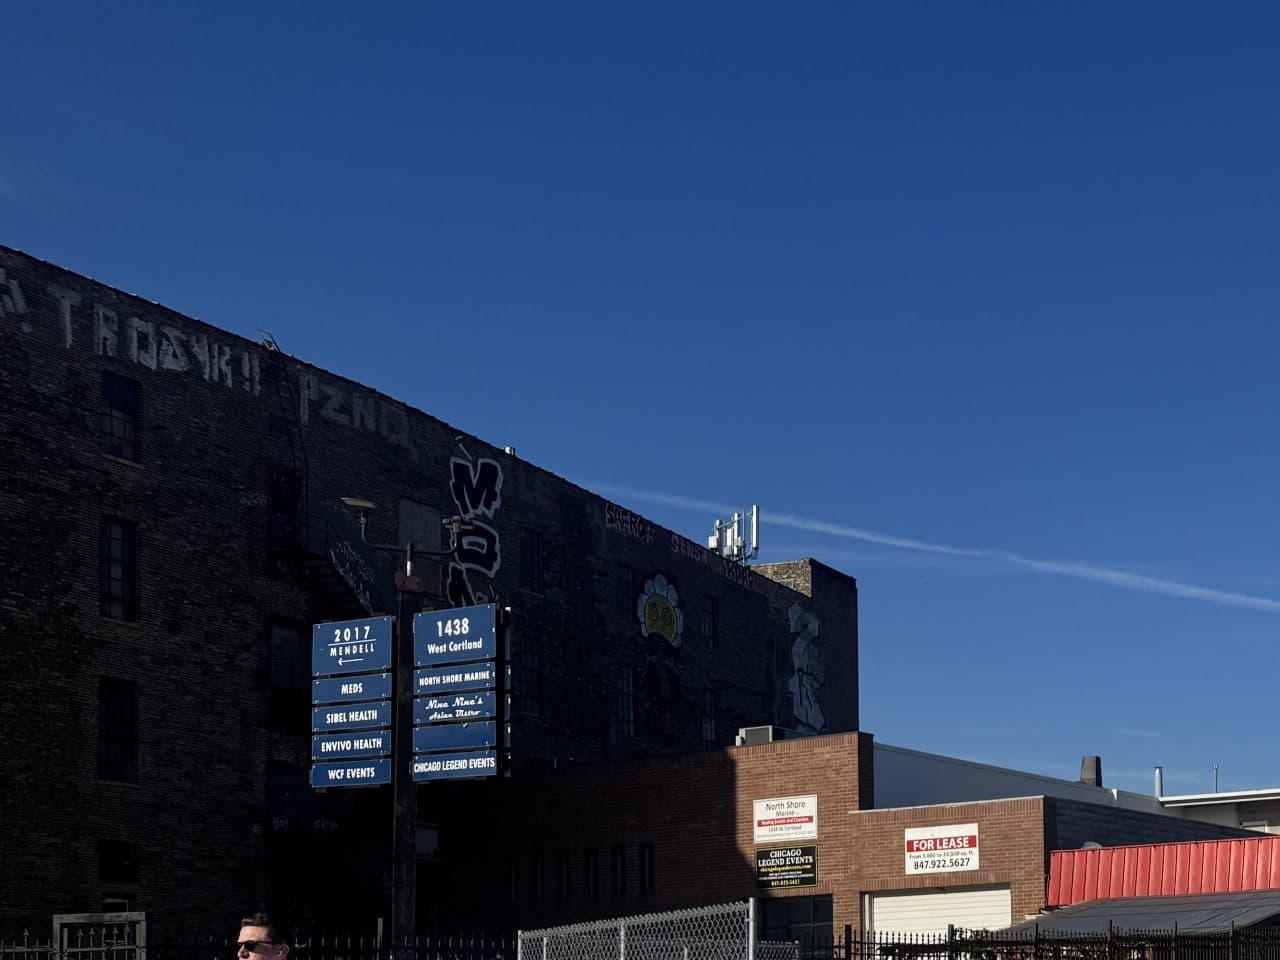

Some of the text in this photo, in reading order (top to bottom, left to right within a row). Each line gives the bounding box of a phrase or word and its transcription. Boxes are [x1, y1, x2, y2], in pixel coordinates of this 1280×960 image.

[334, 626, 370, 642] 2017
[436, 617, 470, 637] 1438
[330, 643, 374, 656] MENDELL
[427, 637, 483, 655] West Cortland
[419, 670, 490, 686] NORTH SHORE MARINE
[341, 682, 363, 694] MEDS
[326, 709, 378, 724] SIBEL HEALTH
[321, 738, 382, 752] ENVIVO HEALTH
[414, 757, 495, 773] CHICAGO LEGEND EVENTS
[328, 767, 375, 780] WCF EVENTS
[766, 800, 806, 811] North Shore
[913, 836, 970, 851] FOR LEASE
[770, 849, 802, 858] CHICAGO
[758, 855, 814, 867] LEGEND EVENTS
[914, 858, 970, 870] 847.922.5627
